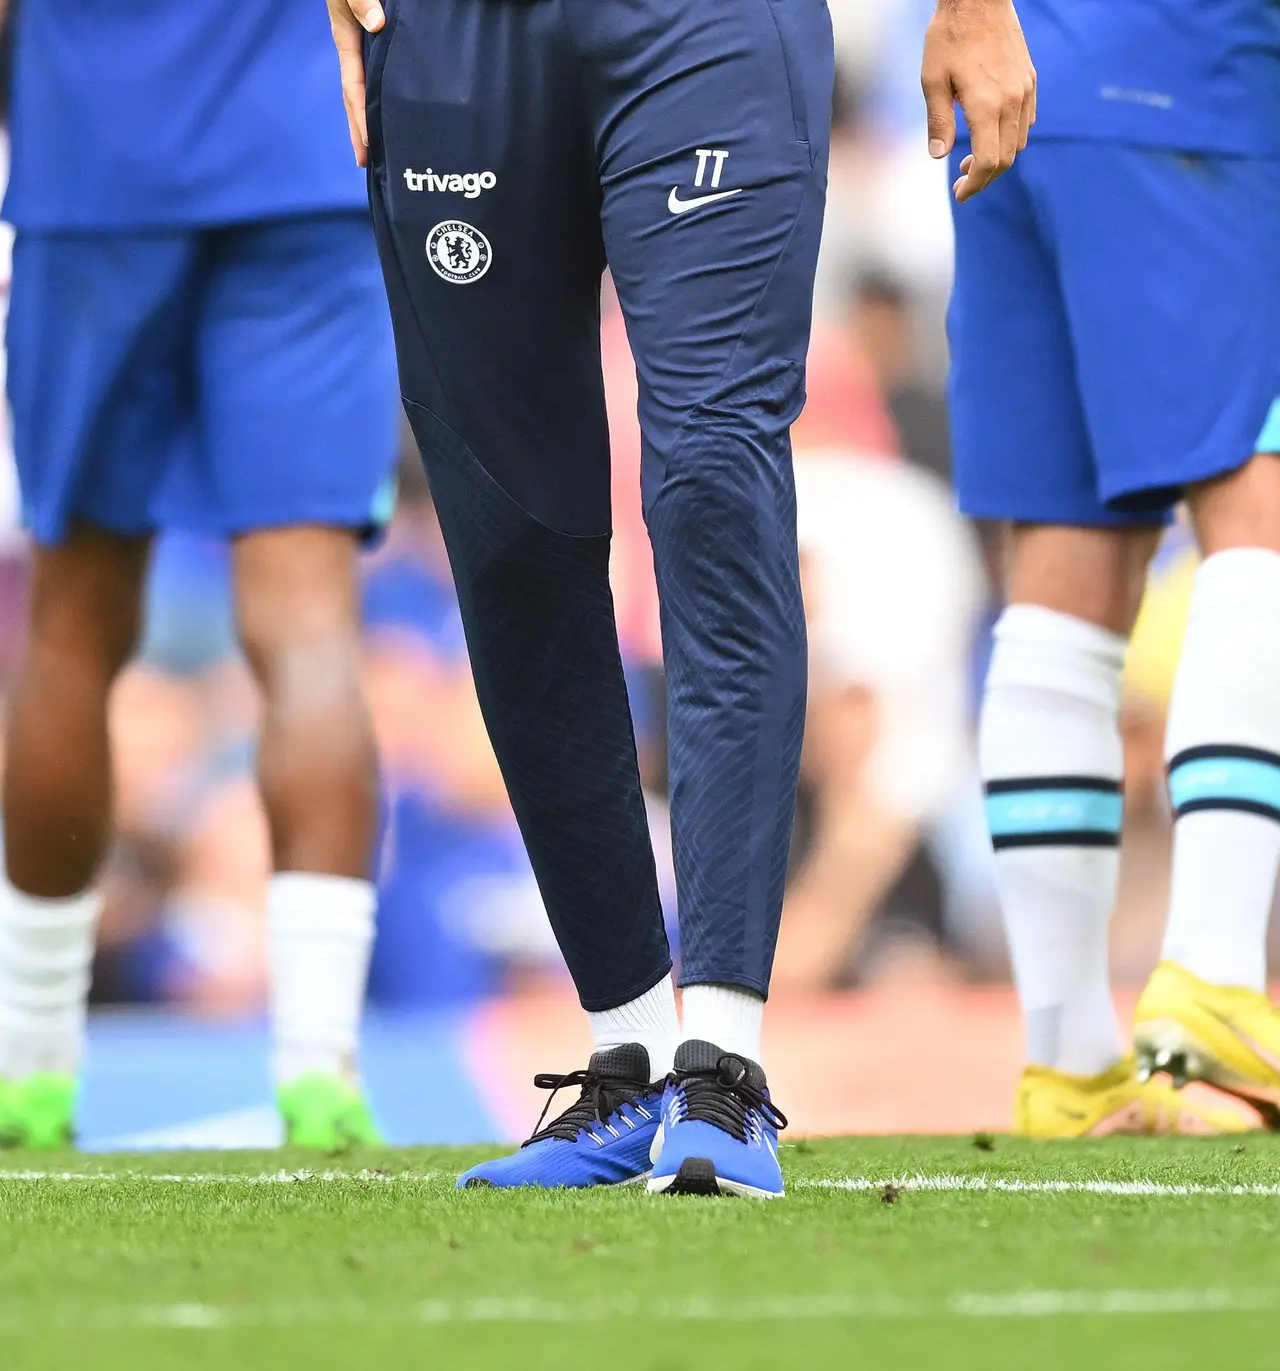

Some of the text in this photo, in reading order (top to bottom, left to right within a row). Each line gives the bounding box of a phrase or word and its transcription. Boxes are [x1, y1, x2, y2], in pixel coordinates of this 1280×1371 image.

[694, 148, 730, 188] TT
[402, 167, 497, 199] trivago
[435, 224, 474, 237] CHELSEA
[440, 267, 482, 280] FOOTBALL CLUB
